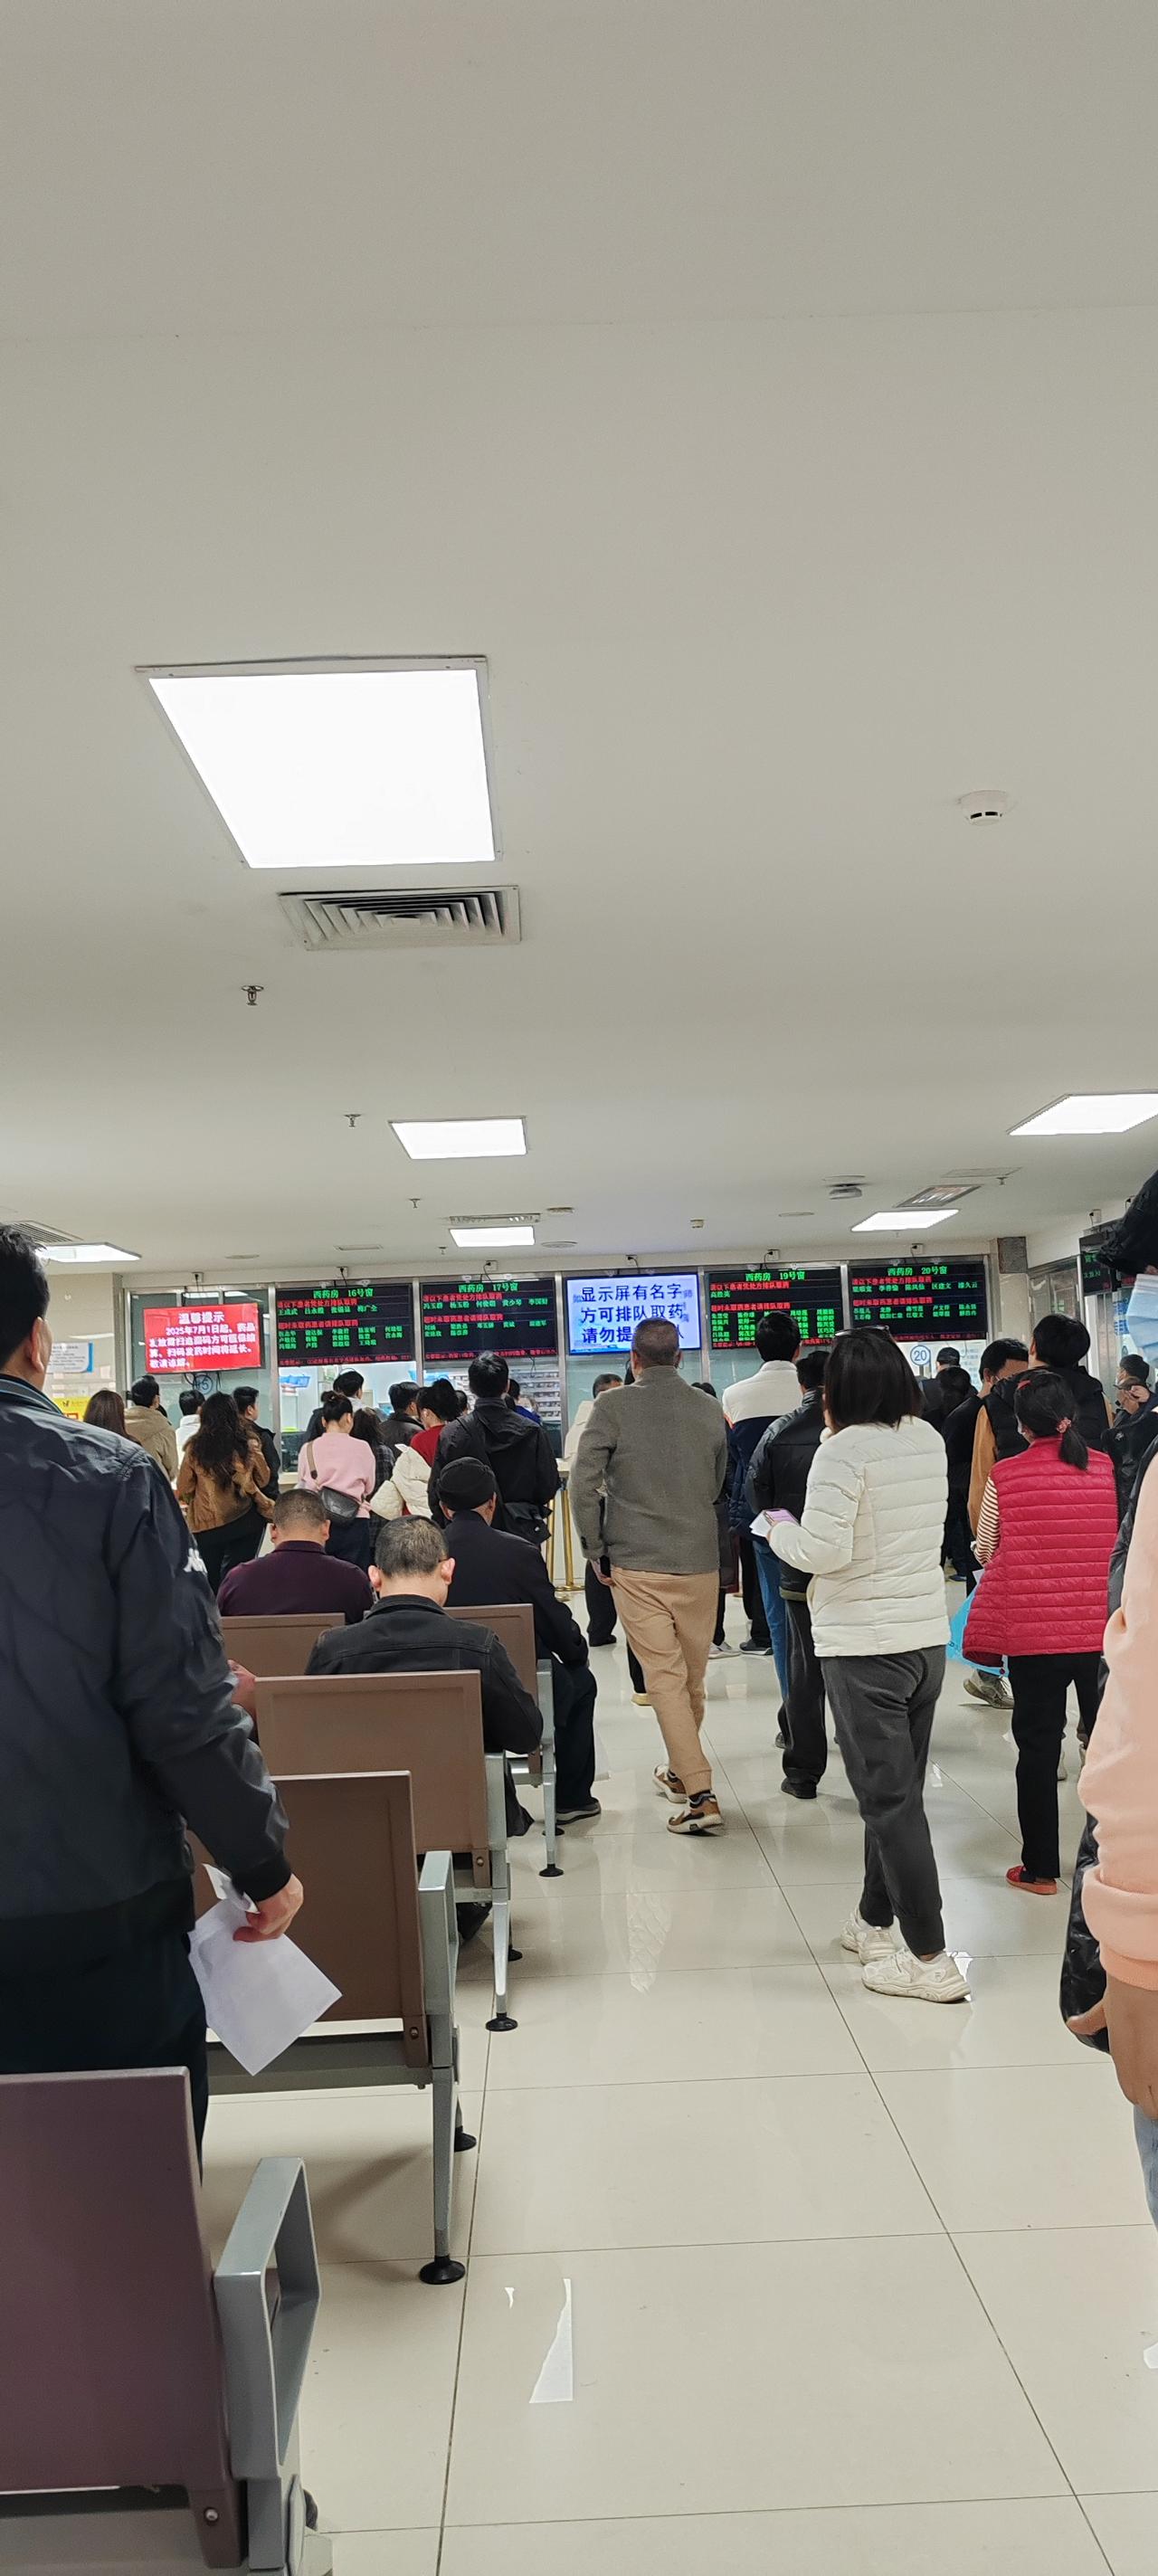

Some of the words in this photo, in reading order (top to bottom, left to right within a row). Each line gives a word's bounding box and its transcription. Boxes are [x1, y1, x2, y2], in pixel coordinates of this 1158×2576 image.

[745, 1272, 771, 1281] 西药房
[780, 1270, 805, 1280] 19号窗
[921, 1266, 947, 1275] 20号窗
[459, 1284, 484, 1293] 西药房
[493, 1282, 518, 1291] 17号窗
[581, 1283, 682, 1302] 显示屏有名字
[313, 1289, 339, 1299] 西药房
[347, 1288, 374, 1298] 16号窗
[179, 1311, 224, 1324] 温馨提示
[581, 1304, 683, 1323] 方可排队取药
[582, 1325, 684, 1344] 请勿提
[914, 1350, 927, 1361] 20
